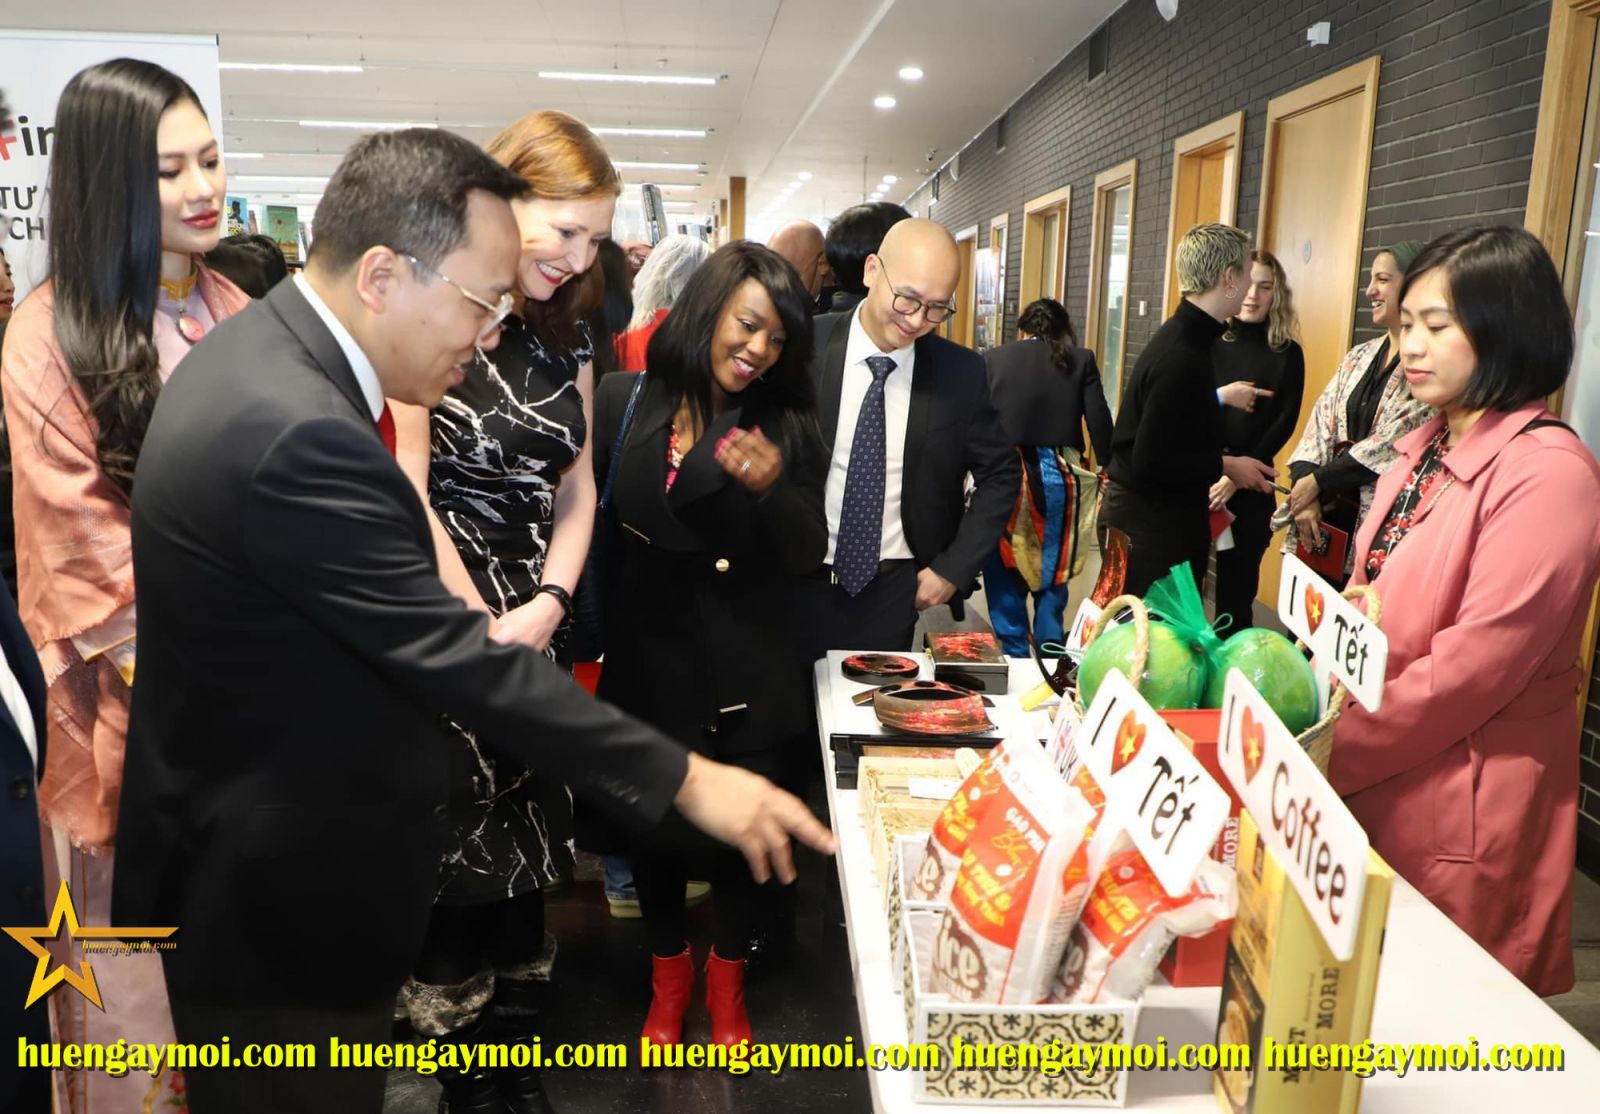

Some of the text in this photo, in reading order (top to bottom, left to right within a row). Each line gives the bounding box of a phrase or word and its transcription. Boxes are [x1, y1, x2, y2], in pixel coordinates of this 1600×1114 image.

[1288, 575, 1369, 685] I Tết
[1091, 697, 1199, 855] I Tết
[1225, 694, 1346, 926] I Coffee
[1315, 966, 1341, 1030] MORE
[1283, 1027, 1306, 1085] MT
